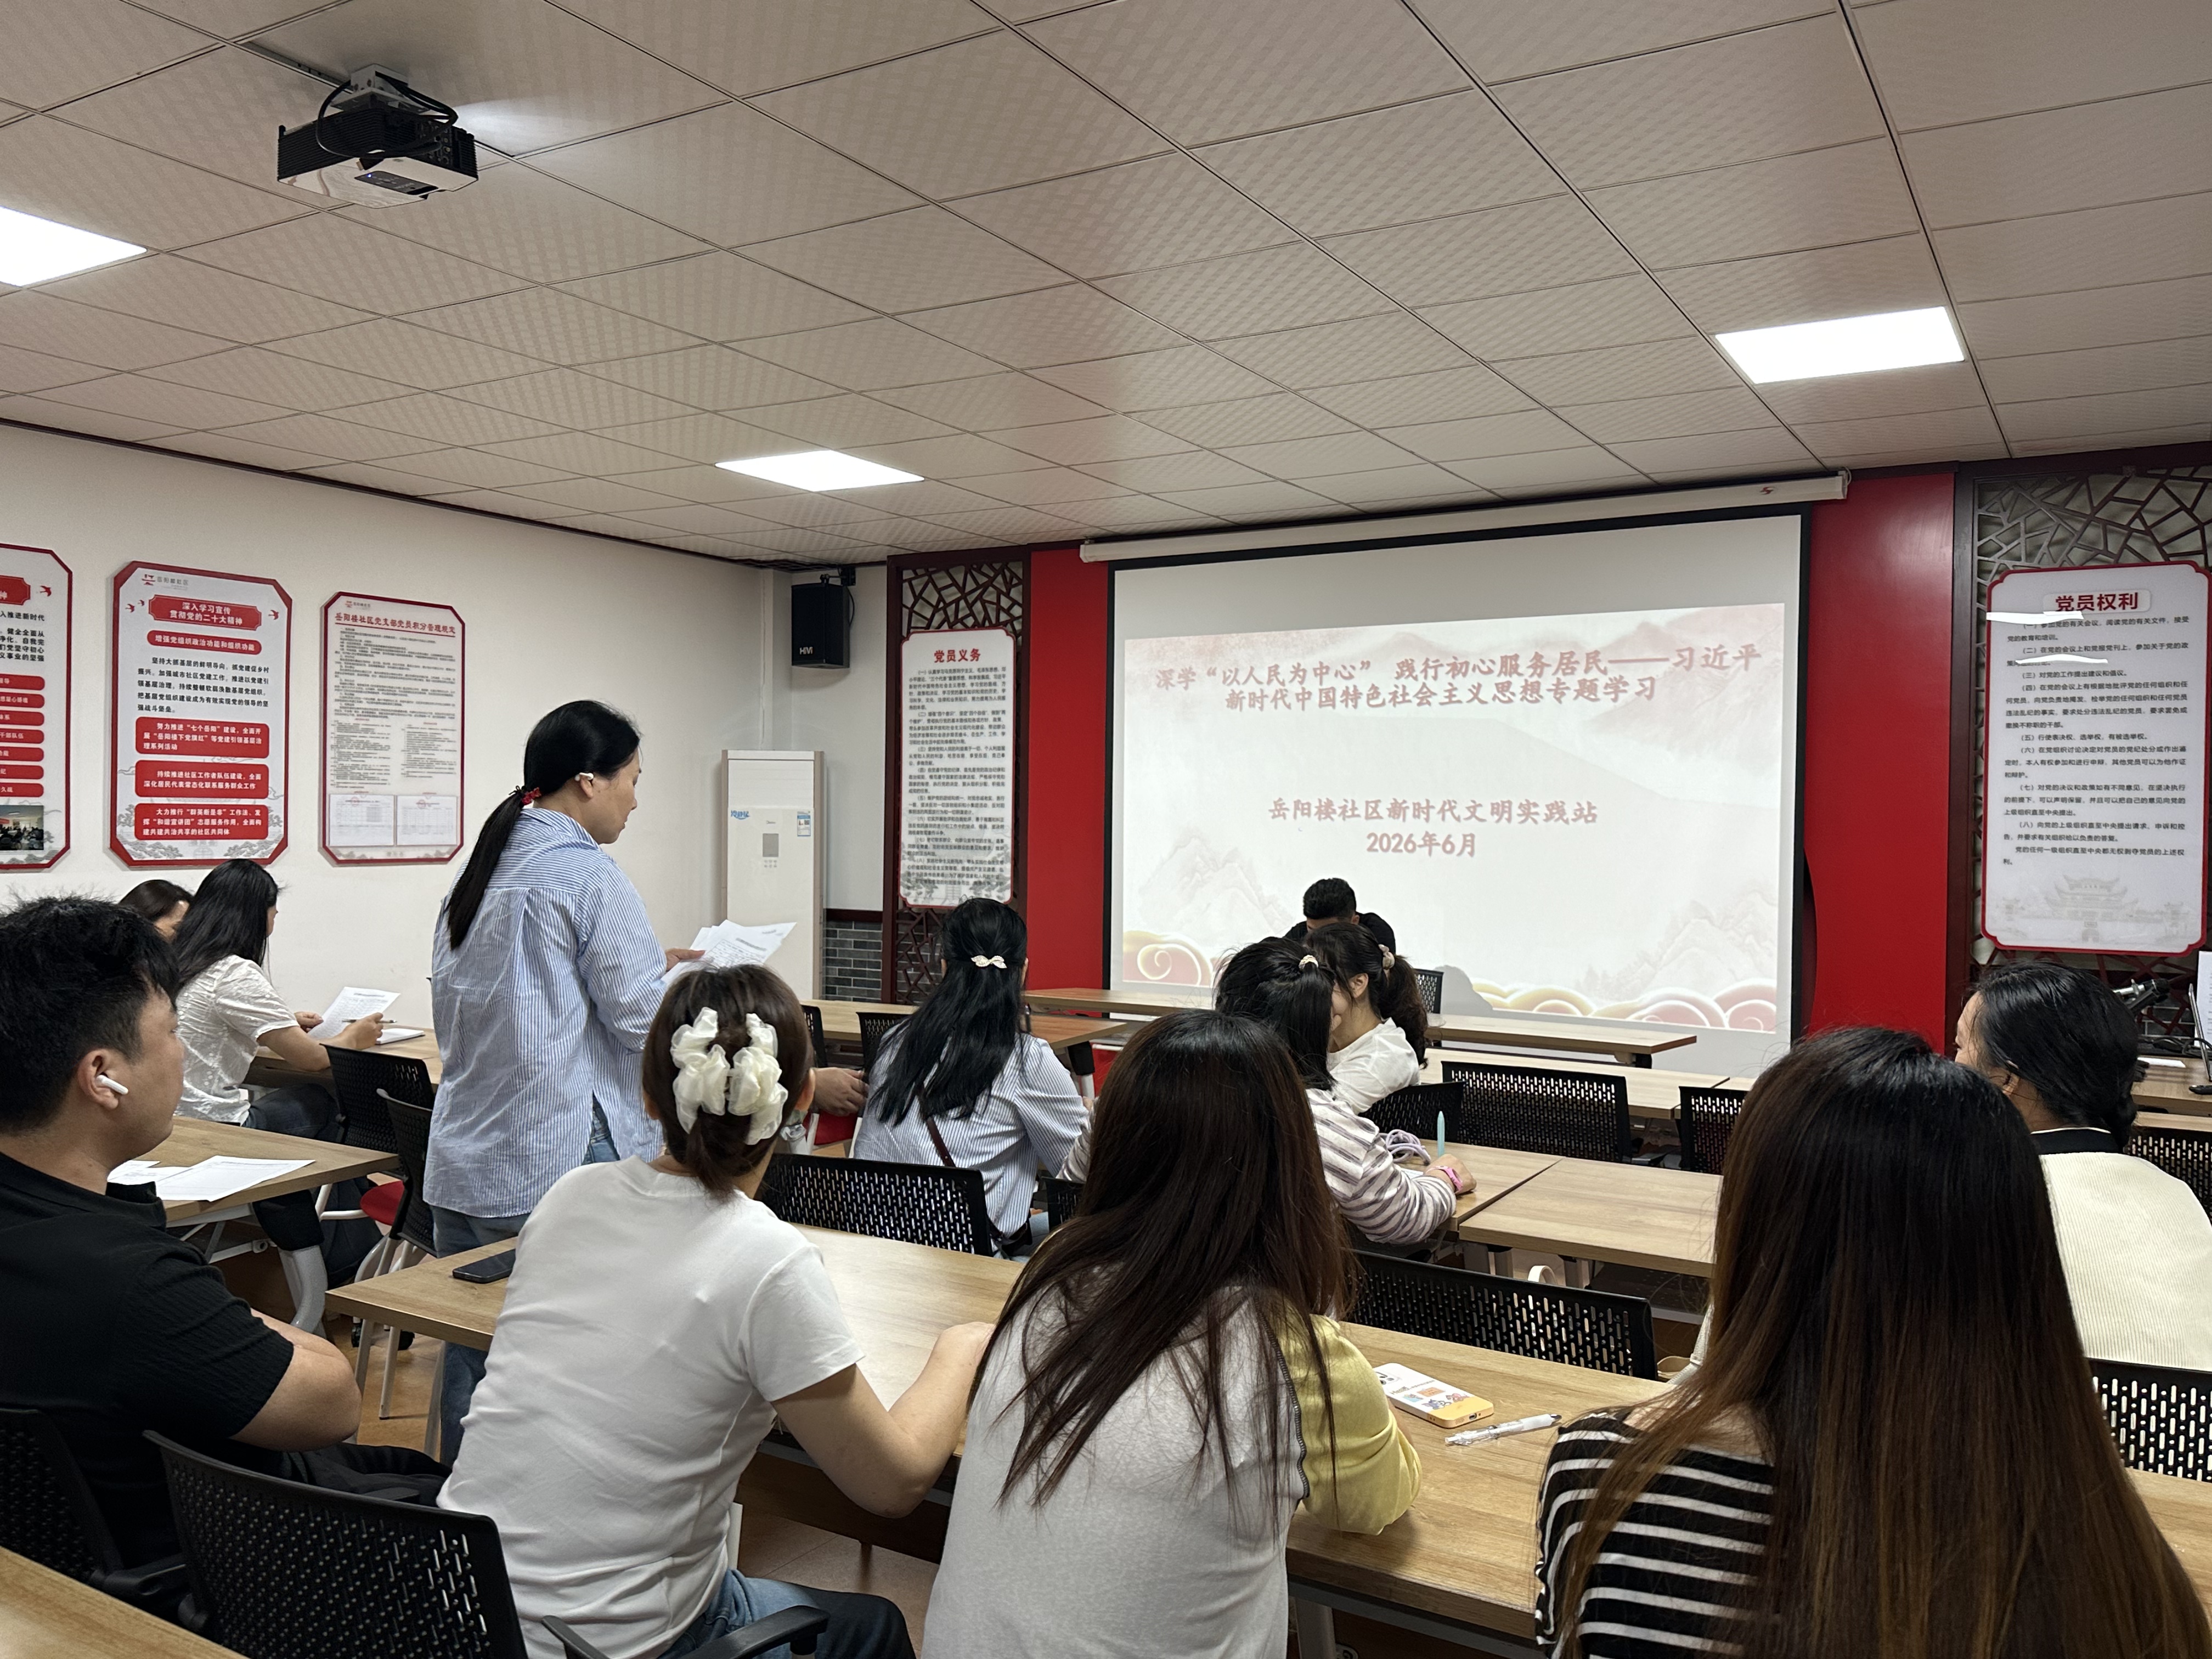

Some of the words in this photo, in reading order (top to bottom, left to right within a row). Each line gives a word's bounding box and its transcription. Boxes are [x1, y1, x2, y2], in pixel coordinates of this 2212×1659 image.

[182, 602, 231, 614] 深入学习宣传
[2056, 592, 2138, 612] 党员权利
[0, 611, 45, 621] 入推进新时代
[170, 610, 242, 625] 贯彻党的二十大精神
[335, 612, 455, 634] 岳阳楼社区党支部党员积分管理规定
[155, 635, 255, 651] 增强党组织政治功能和组织功能
[0, 652, 44, 662] 义事业的坚强
[934, 648, 981, 663] 党员义务
[1395, 643, 1762, 681] 践行初心服务居民——习近平
[1224, 675, 1657, 712] 新时代中国特色社会主义思想专题学习
[144, 780, 256, 789] 深化居民代表常态化联系服务群众工作
[1268, 797, 1598, 825] 岳阳楼社区新时代文明实践站
[1366, 830, 1477, 857] 2026年6月
